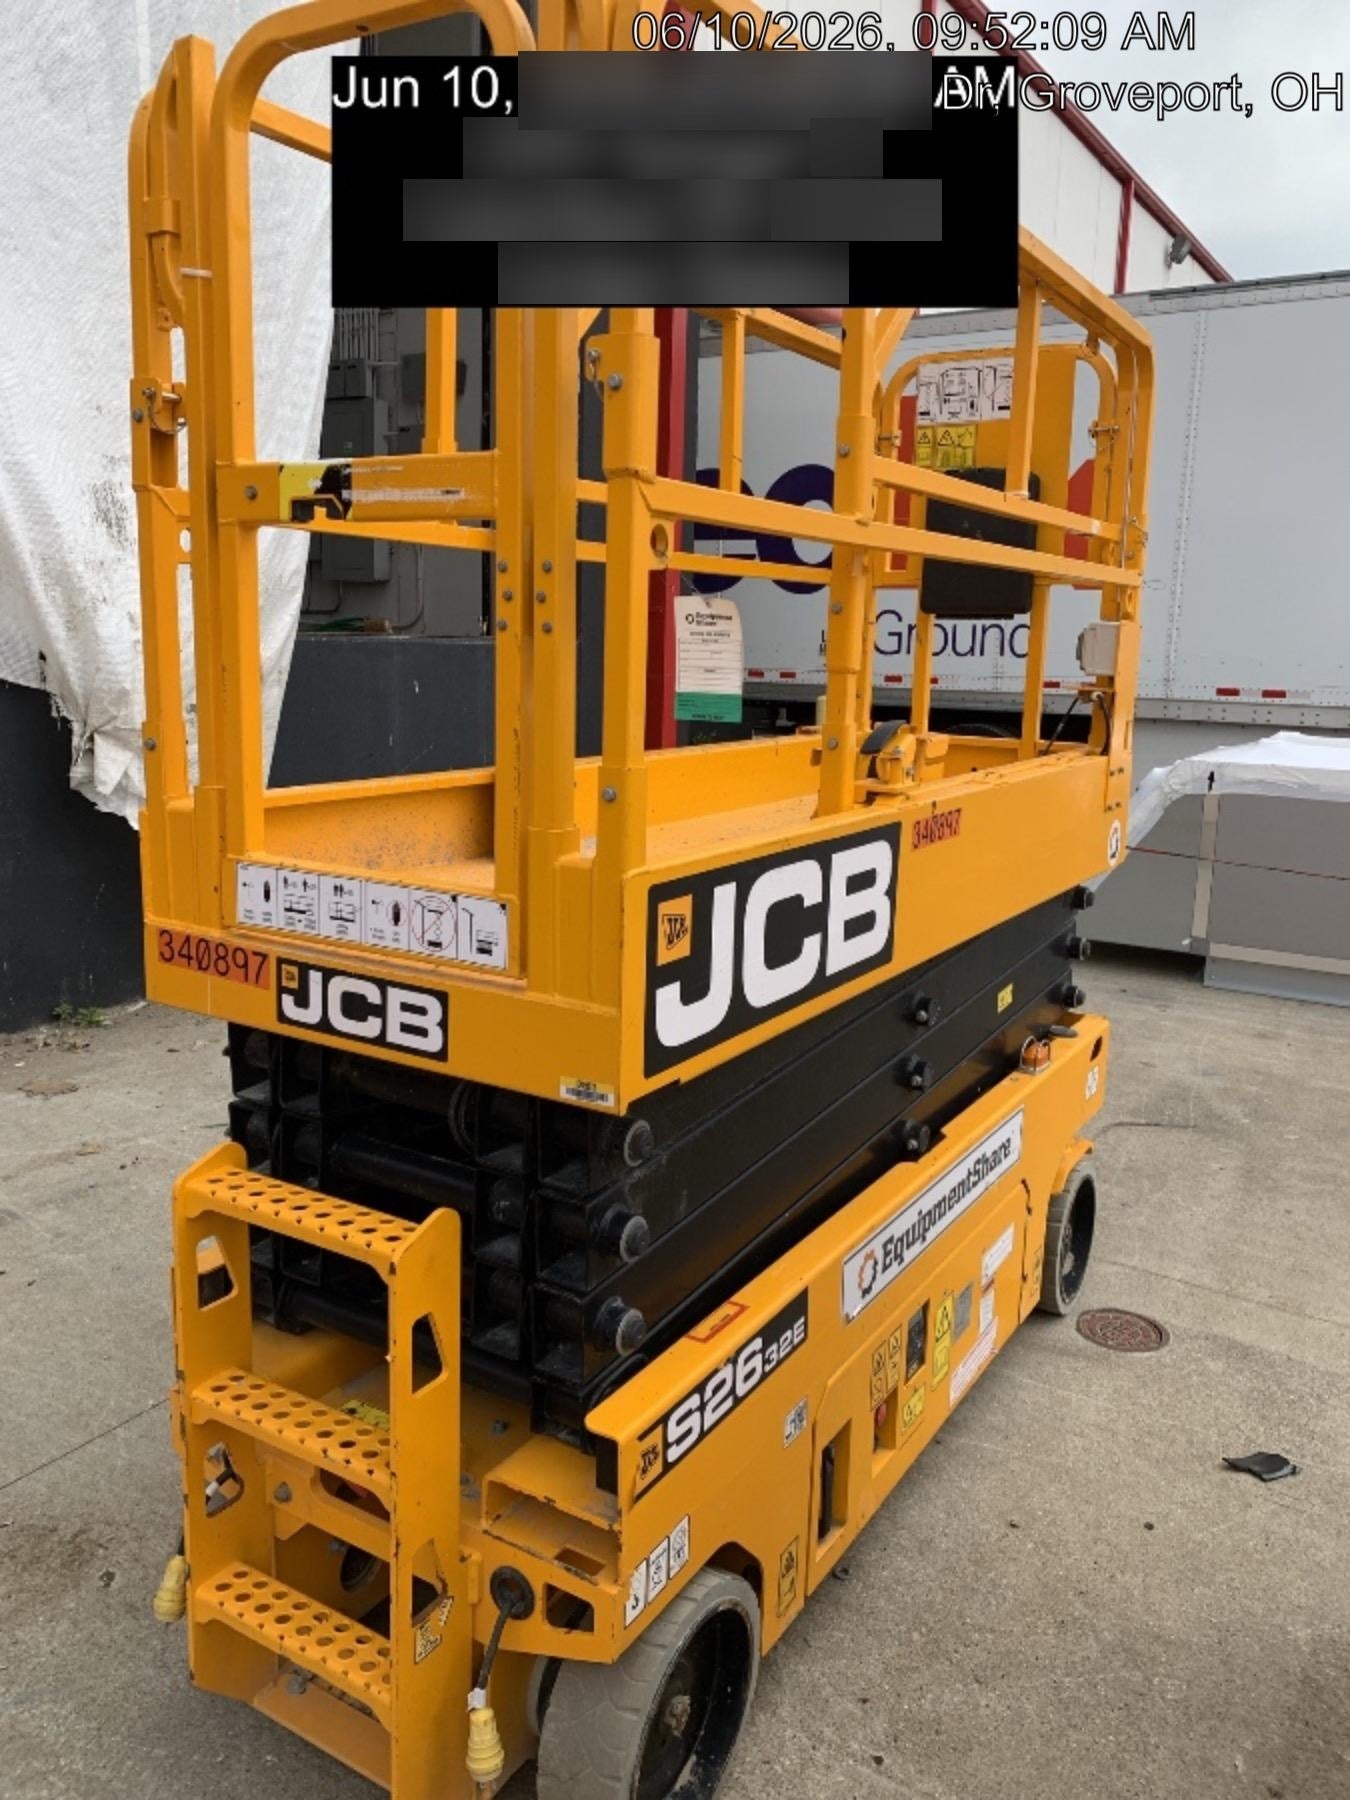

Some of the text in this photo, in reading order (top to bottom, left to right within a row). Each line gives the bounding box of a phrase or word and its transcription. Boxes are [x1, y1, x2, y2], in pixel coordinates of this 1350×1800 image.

[159, 928, 269, 985] 340897
[655, 839, 893, 1047] JCB
[281, 969, 443, 1053] JCB
[881, 1138, 1011, 1275] EquipmentShare
